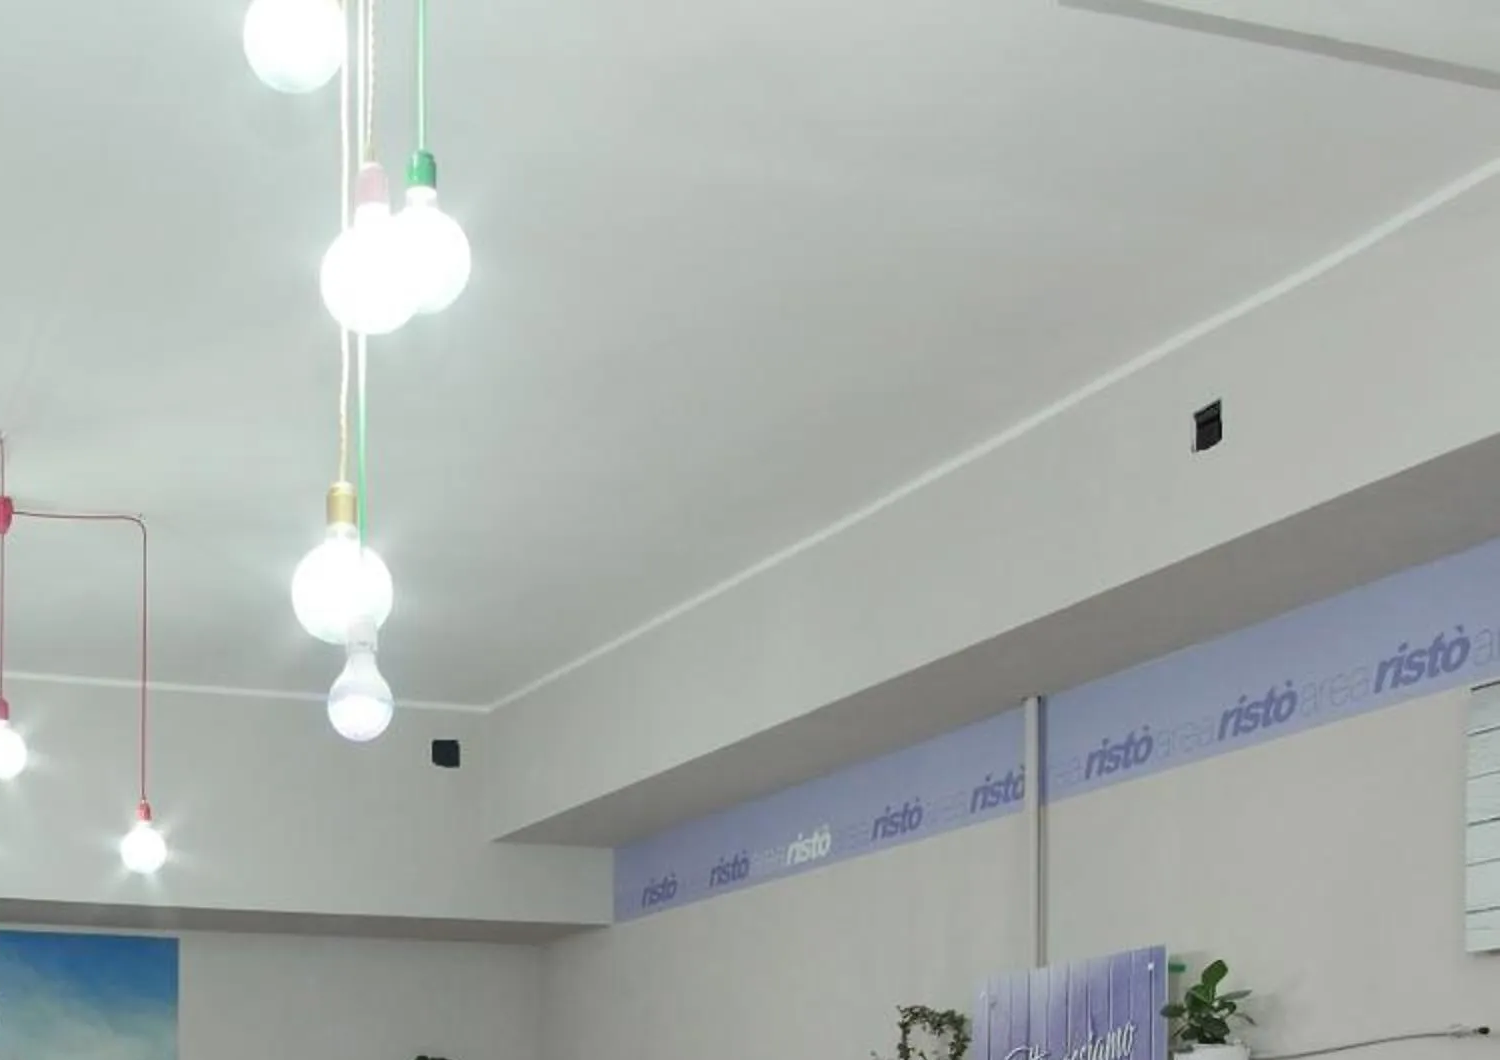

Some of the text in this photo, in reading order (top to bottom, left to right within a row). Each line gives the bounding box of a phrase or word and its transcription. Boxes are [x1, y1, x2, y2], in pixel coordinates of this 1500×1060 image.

[709, 850, 750, 887] ristò
[787, 824, 832, 865] ristò
[871, 797, 923, 841] ristò
[1084, 724, 1154, 779] ristò
[1217, 680, 1297, 741] ristò
[1373, 624, 1471, 694] ristò
